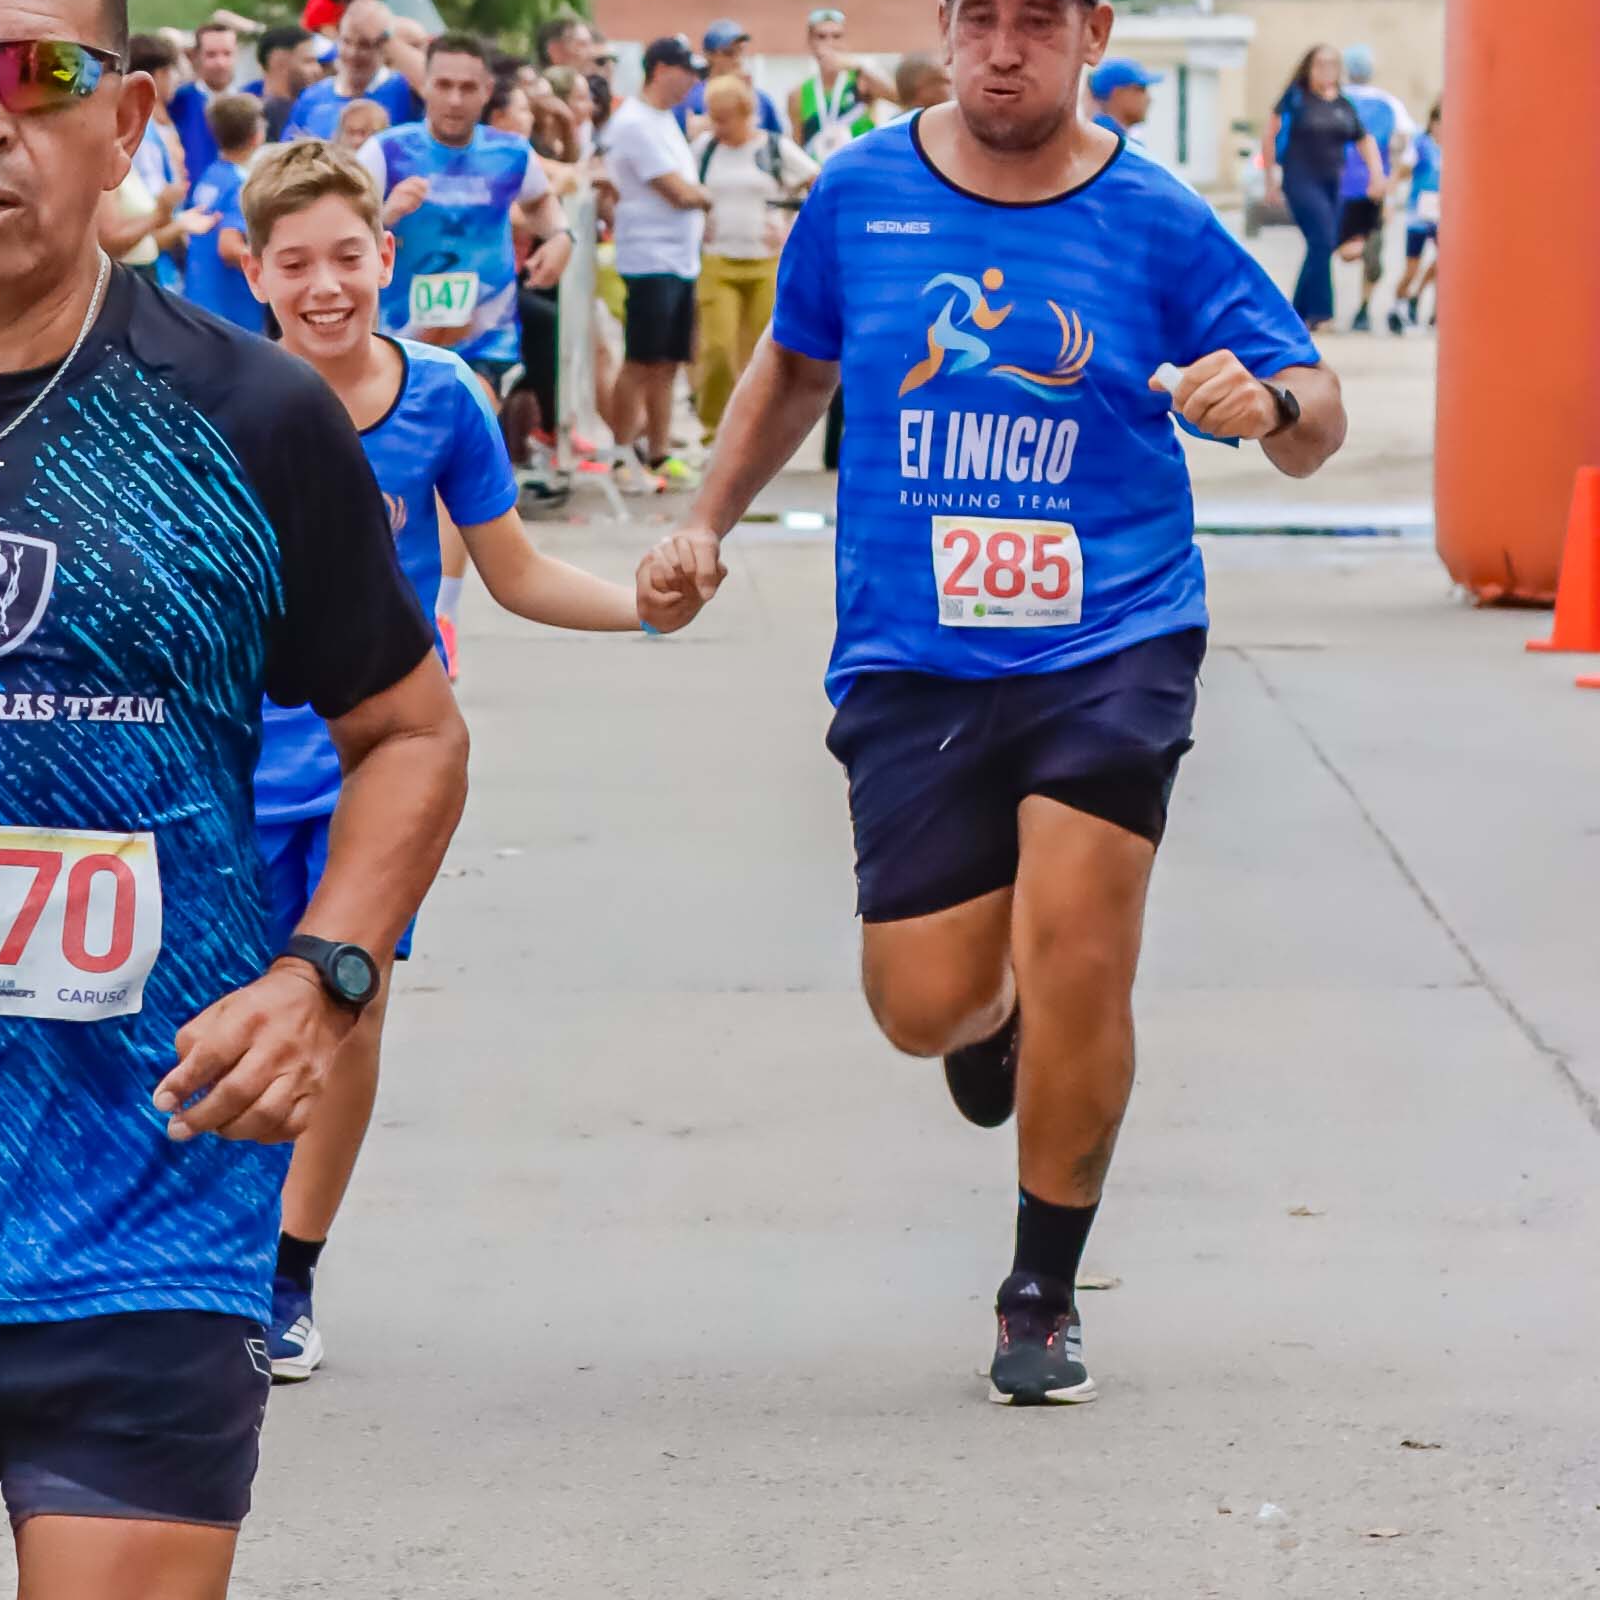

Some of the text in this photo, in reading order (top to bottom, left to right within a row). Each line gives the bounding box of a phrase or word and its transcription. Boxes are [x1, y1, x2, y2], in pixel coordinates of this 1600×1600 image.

[866, 220, 931, 234] HERMES
[415, 279, 470, 312] 047
[943, 410, 1080, 485] INICIO
[900, 490, 1071, 511] RUNNING TEAM
[943, 528, 1072, 601] 285
[64, 695, 165, 724] TEAM
[57, 987, 128, 1004] CARUSO
